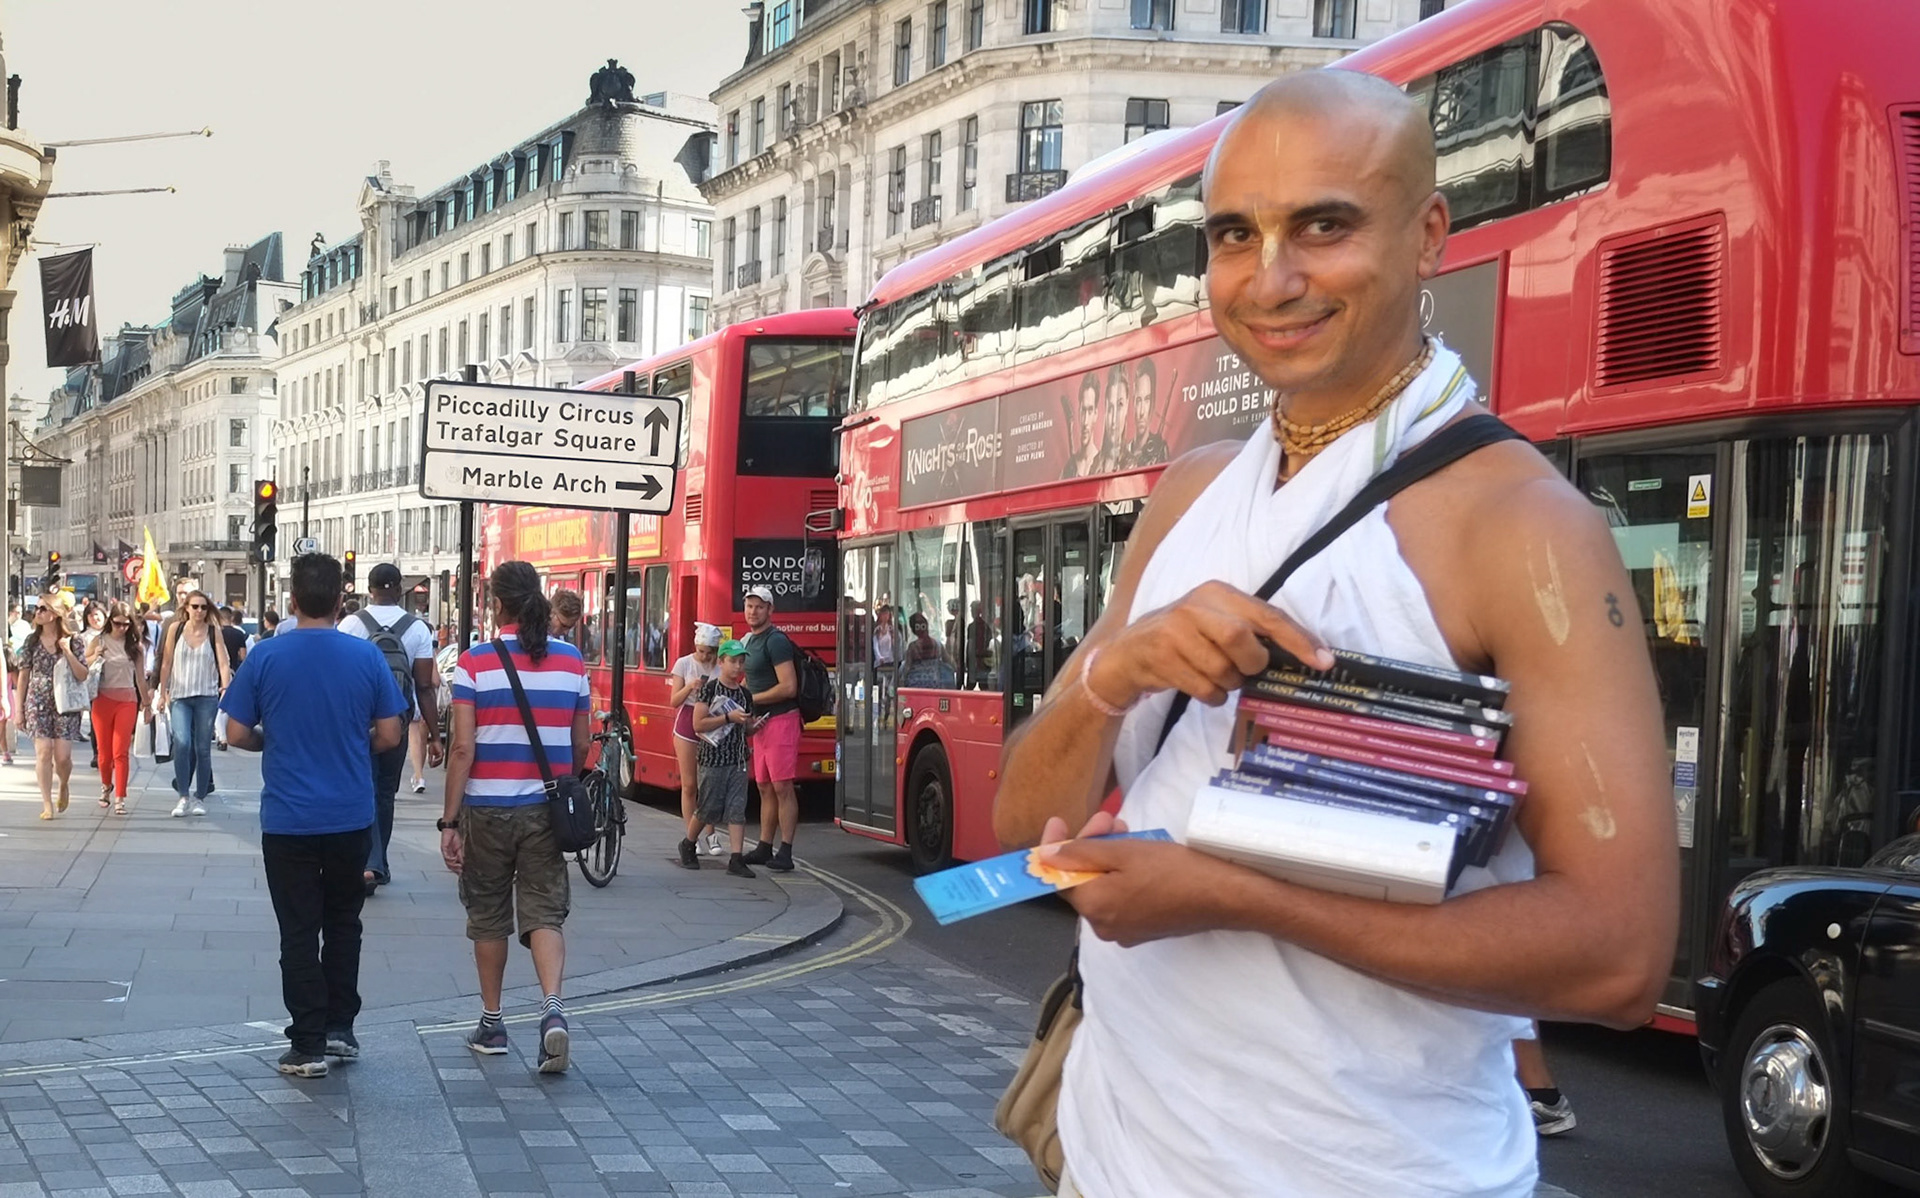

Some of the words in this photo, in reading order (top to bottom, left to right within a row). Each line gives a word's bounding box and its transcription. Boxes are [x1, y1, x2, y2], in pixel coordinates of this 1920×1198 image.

[1182, 384, 1198, 402] TO
[1201, 372, 1250, 398] IMAGINE
[436, 394, 549, 423] Piccadilly
[559, 401, 634, 425] Circus
[1197, 397, 1237, 420] COULD
[1241, 392, 1259, 411] BE
[436, 421, 543, 448] Trafalgar
[553, 428, 636, 451] Square
[906, 443, 956, 485] KNIGHTS
[966, 427, 1002, 467] ROSE
[462, 467, 543, 489] Marble
[553, 472, 607, 494] Arch
[742, 556, 825, 569] LOND
[806, 624, 819, 632] red
[821, 624, 836, 632] bus
[1331, 648, 1367, 661] HAPPY
[1257, 681, 1296, 696] CHANT
[1294, 690, 1311, 700] and
[1323, 695, 1360, 709] HAPPY
[1267, 670, 1305, 683] CHANT
[1305, 679, 1321, 687] and
[1333, 683, 1370, 696] HAPPY
